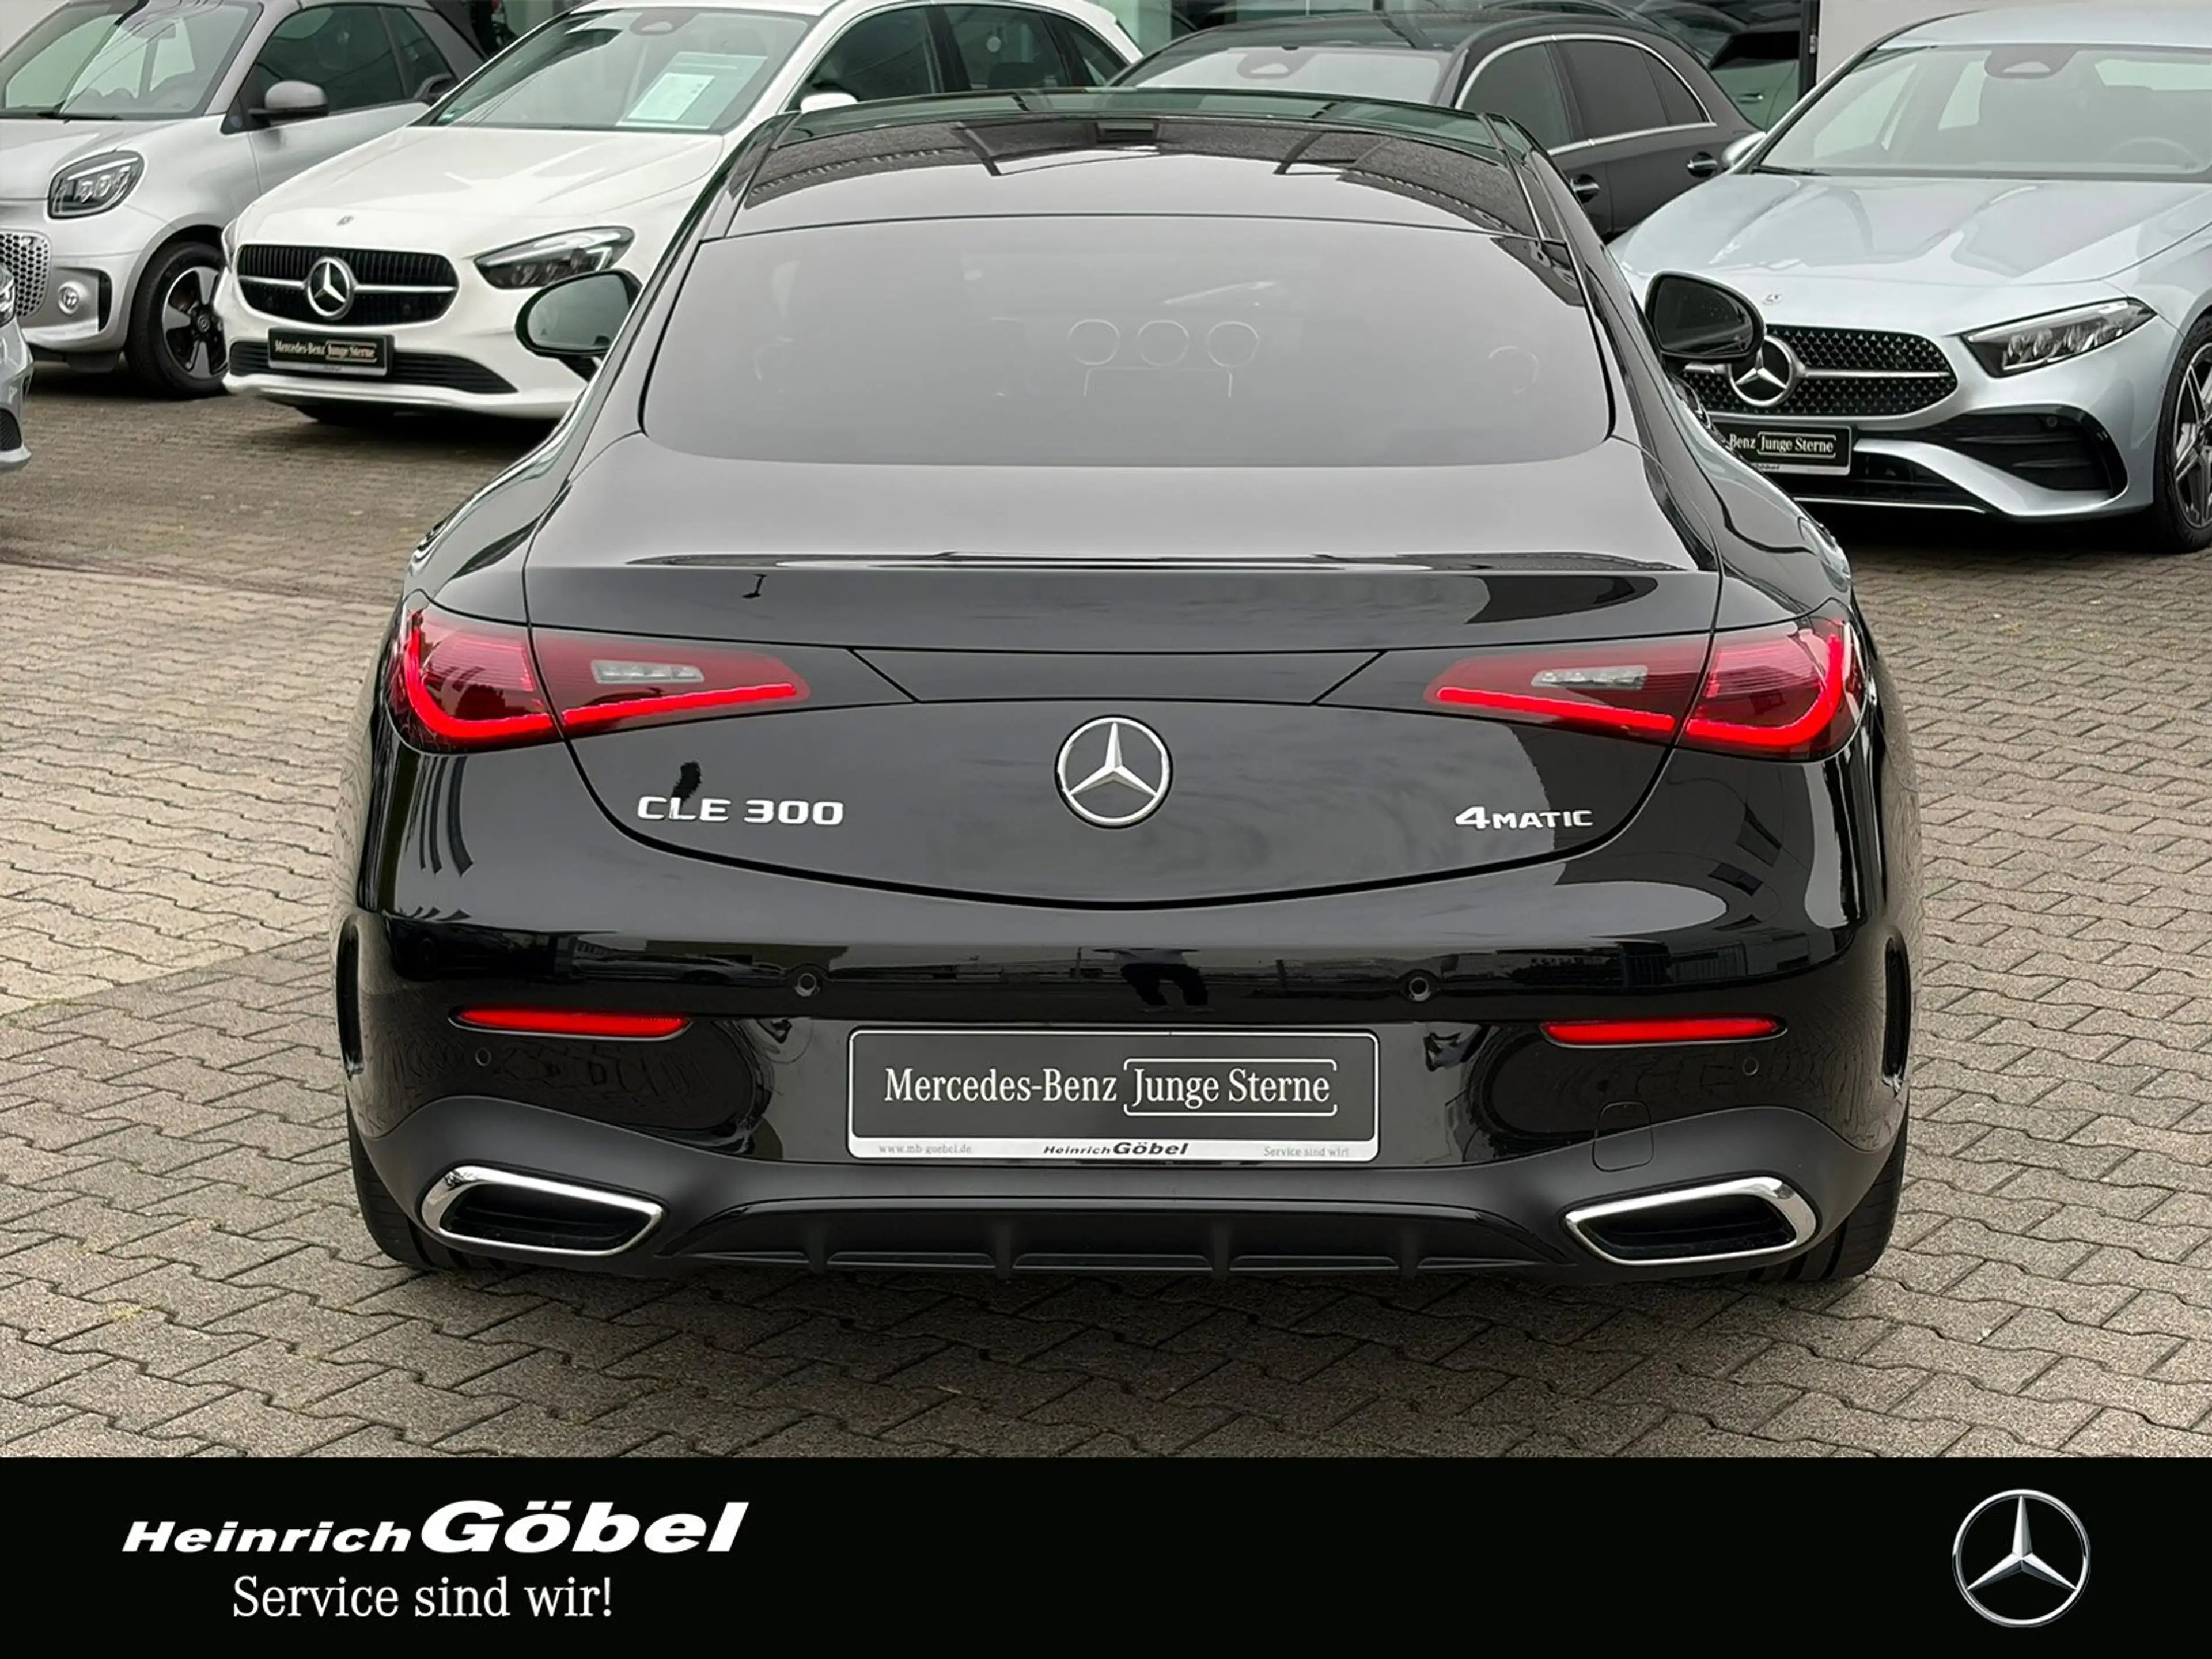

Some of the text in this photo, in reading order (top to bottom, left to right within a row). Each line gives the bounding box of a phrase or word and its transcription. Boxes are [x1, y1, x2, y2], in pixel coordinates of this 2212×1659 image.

[1729, 433, 1834, 453] Benz Junge Sterne
[637, 796, 844, 825] CLE 300
[1455, 806, 1593, 829] 4MATIC
[884, 1067, 1330, 1110] Mercedes-Benz Junge Sterne
[1112, 1142, 1189, 1156] Göbel
[1263, 1146, 1302, 1157] Service
[1304, 1147, 1325, 1157] sind
